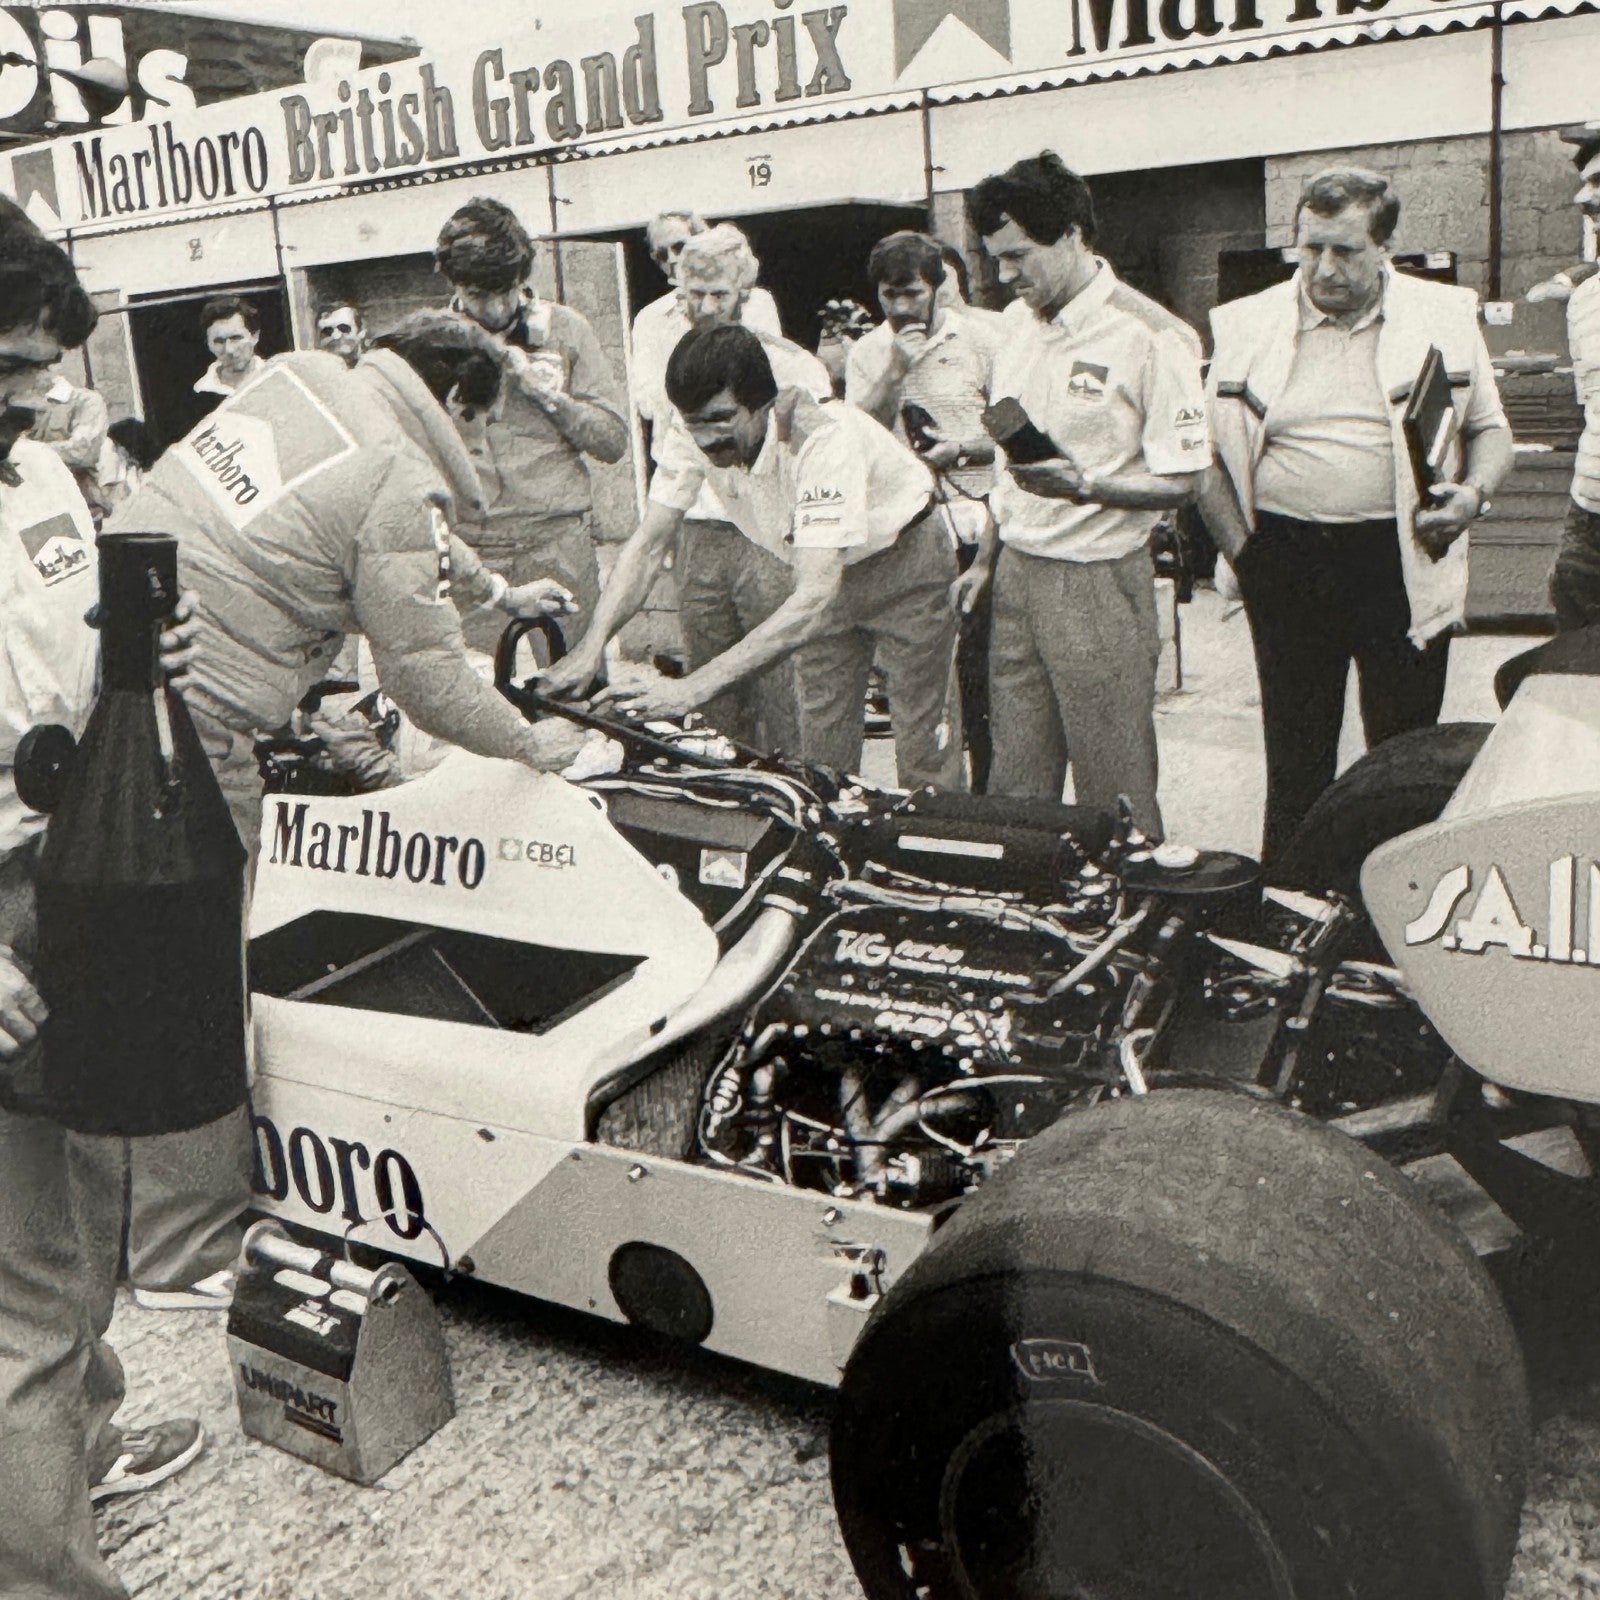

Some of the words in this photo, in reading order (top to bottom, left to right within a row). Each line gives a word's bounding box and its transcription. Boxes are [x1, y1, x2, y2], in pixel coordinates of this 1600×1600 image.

[73, 120, 268, 222] Marlboro
[280, 63, 459, 185] British
[472, 13, 664, 153] Grand
[682, 0, 852, 117] Prix
[269, 801, 485, 890] Marlboro
